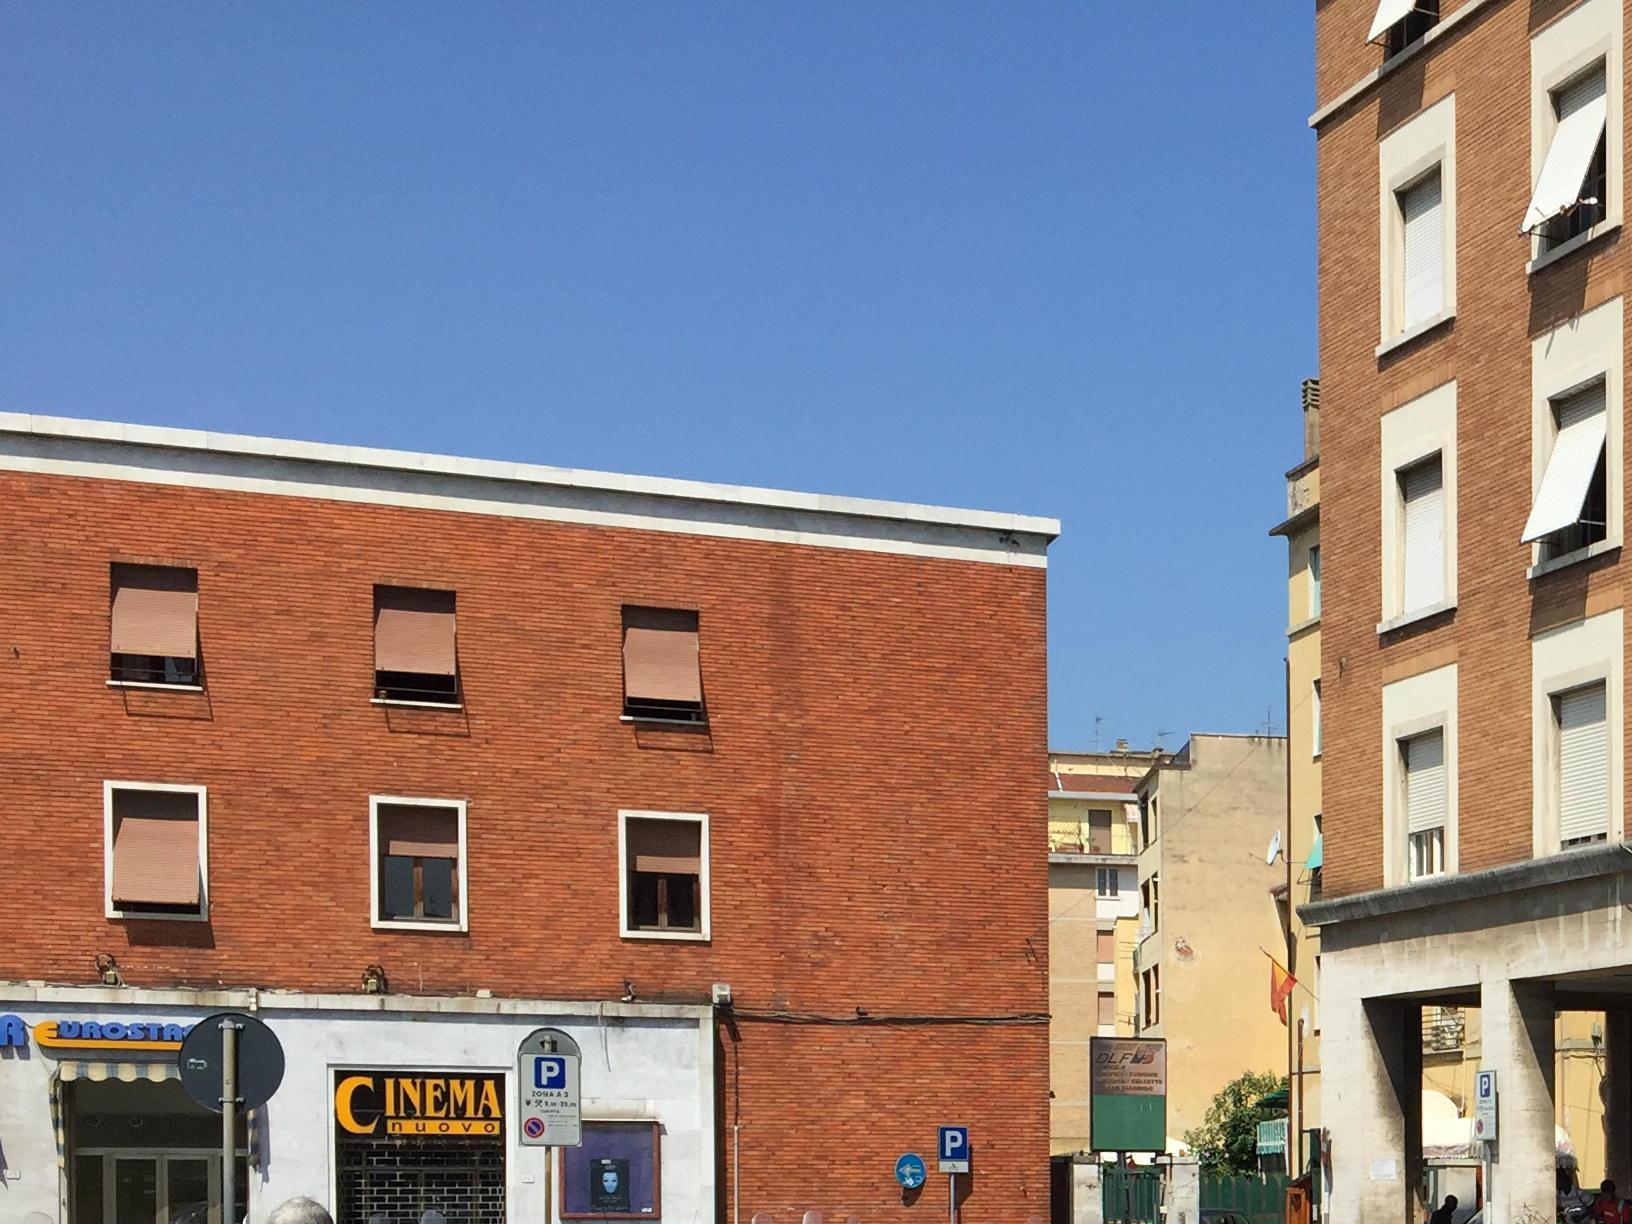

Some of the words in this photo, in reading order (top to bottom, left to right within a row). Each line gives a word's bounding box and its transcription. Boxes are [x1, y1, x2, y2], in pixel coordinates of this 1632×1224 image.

[541, 1061, 560, 1086] P
[335, 1075, 502, 1134] CINEMA
[391, 1121, 496, 1133] nuovo
[945, 1130, 963, 1157] P
